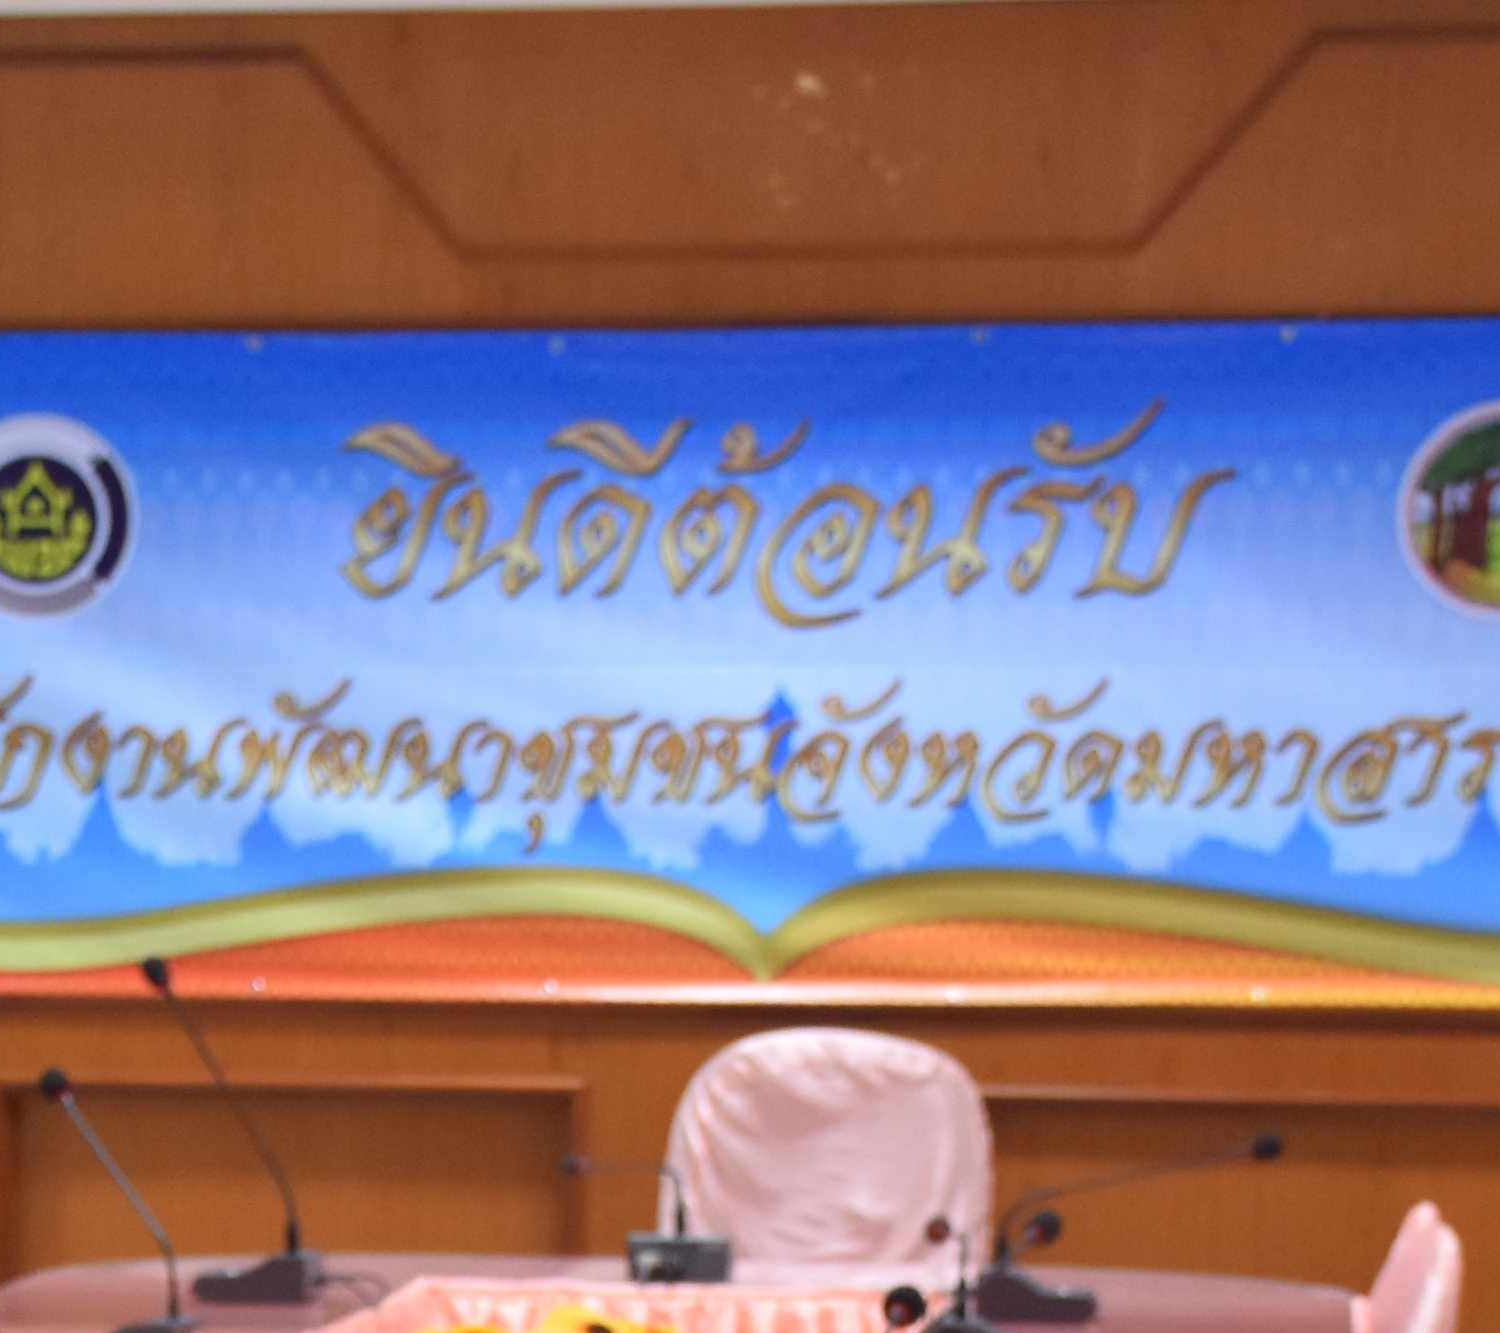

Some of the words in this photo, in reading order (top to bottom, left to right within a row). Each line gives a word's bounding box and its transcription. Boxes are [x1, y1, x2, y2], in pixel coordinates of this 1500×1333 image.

[341, 398, 1236, 628] ยินดีต้อนรับ
